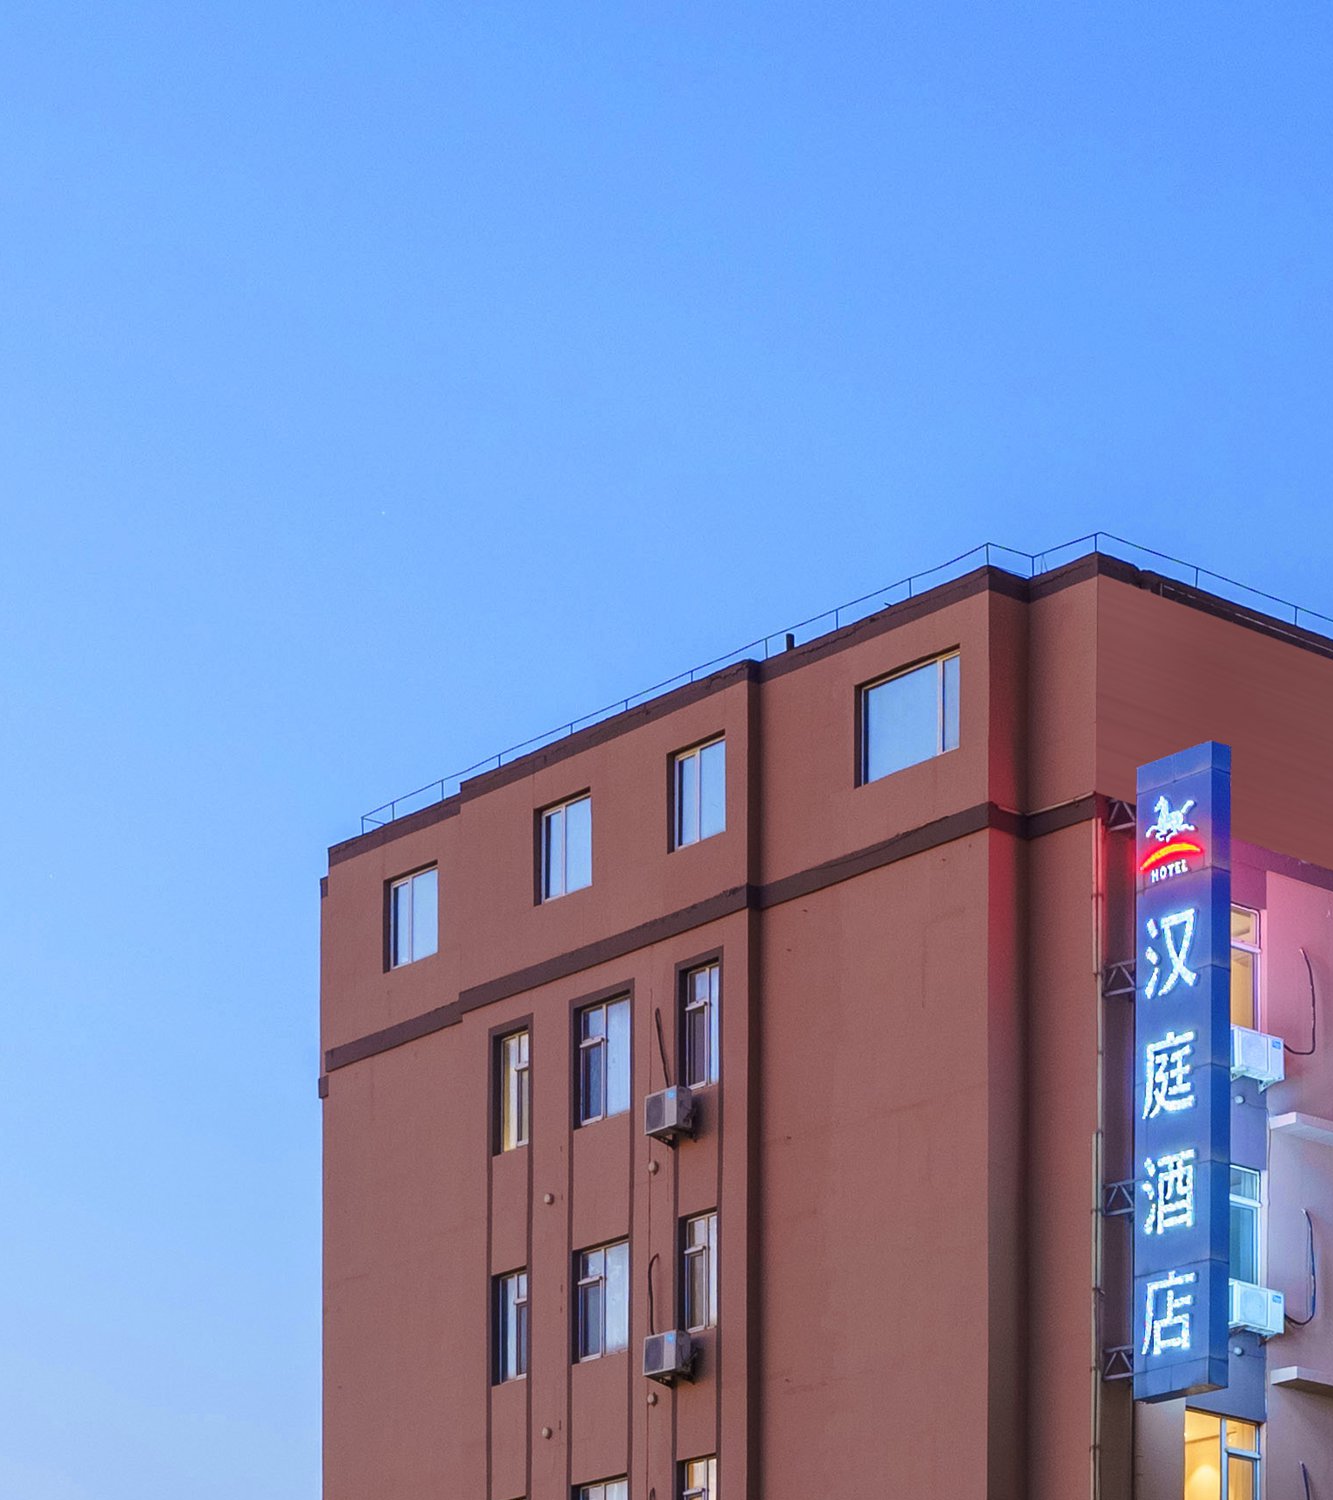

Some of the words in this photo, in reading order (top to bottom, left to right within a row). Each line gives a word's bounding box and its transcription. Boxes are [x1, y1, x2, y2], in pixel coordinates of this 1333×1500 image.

[1151, 859, 1188, 883] HOTEL
[1142, 908, 1197, 1357] 汉庭酒店
